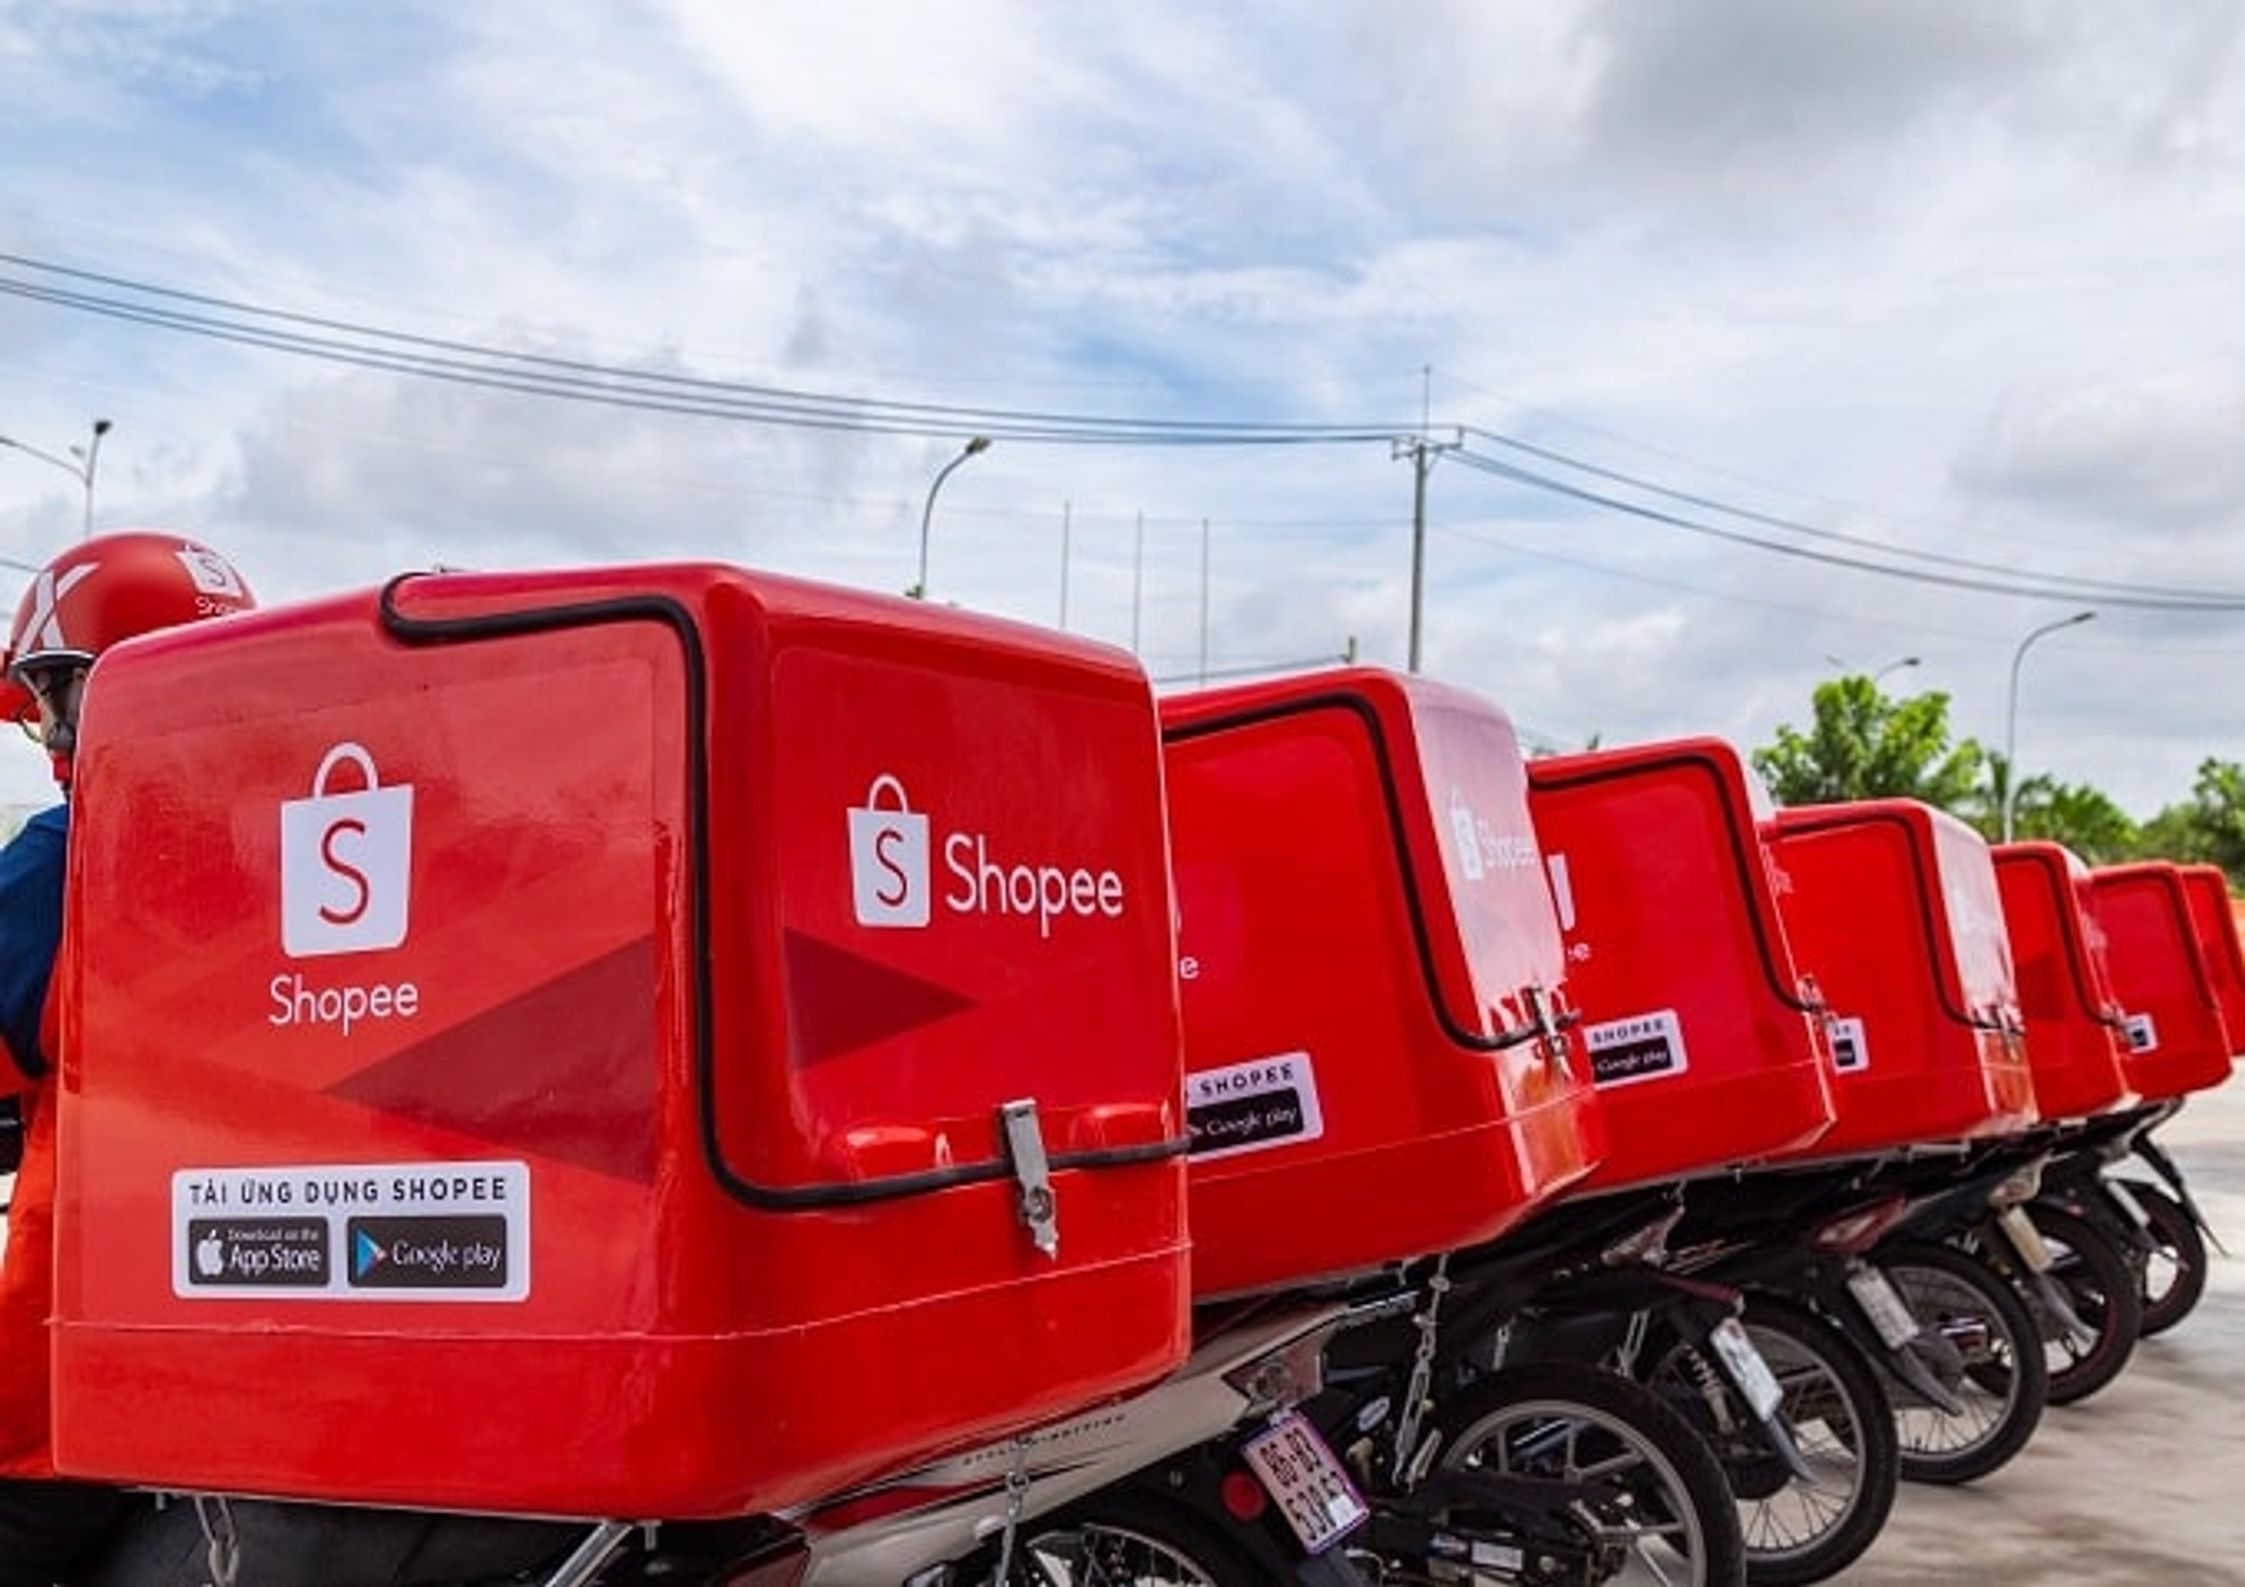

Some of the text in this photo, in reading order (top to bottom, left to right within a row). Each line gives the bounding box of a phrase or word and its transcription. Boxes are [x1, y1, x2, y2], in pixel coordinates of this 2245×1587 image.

[318, 818, 370, 925] S
[874, 829, 908, 907] S
[945, 833, 1124, 938] Shopee
[268, 973, 419, 1037] Shopee
[1592, 1018, 1664, 1043] SHOPEE
[1200, 1062, 1294, 1097] SHOPEE
[1206, 1110, 1261, 1136] Google
[189, 1178, 227, 1204] TẢI
[305, 1179, 379, 1205] DỤNG
[392, 1177, 506, 1201] SHOPEE
[229, 1243, 322, 1276] App Store
[392, 1239, 502, 1274] Google play
